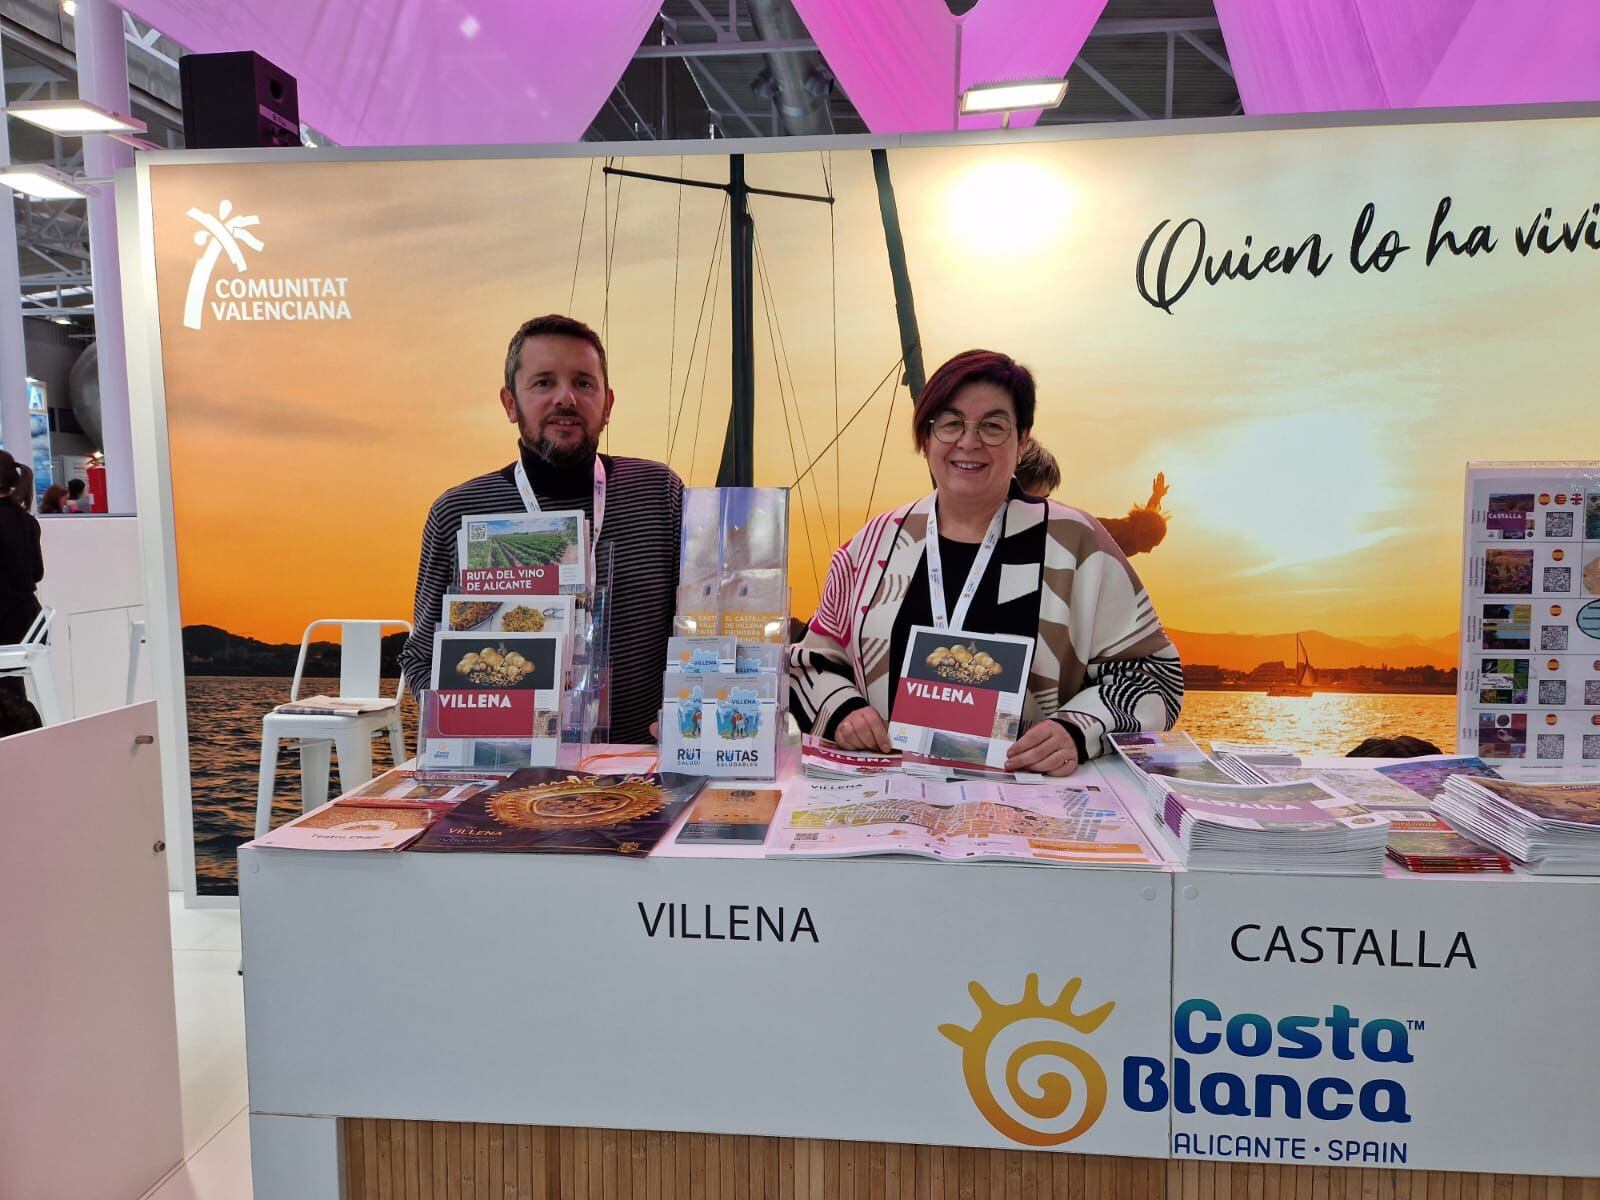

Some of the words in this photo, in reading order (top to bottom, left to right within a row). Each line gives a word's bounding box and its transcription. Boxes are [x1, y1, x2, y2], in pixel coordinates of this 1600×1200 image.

[1136, 218, 1333, 315] Quien
[1350, 202, 1410, 274] lo
[1426, 196, 1498, 267] ha
[215, 277, 348, 299] COMUNITAT
[211, 300, 352, 321] VALENCIANA
[466, 571, 494, 580] RUTA
[496, 570, 515, 579] DEL
[518, 569, 545, 578] VINO
[466, 582, 480, 591] DE
[483, 580, 532, 590] ALICANTE
[439, 694, 512, 708] VILLENA
[905, 682, 975, 705] VILLENA
[716, 750, 758, 762] RUTAS
[637, 902, 819, 943] VILLENA
[1230, 924, 1477, 969] CASTALLA
[1174, 998, 1414, 1064] Costa
[1123, 1056, 1412, 1123] Blanca
[1174, 1132, 1306, 1160] ALICANTE
[1328, 1139, 1407, 1164] SPAIN
